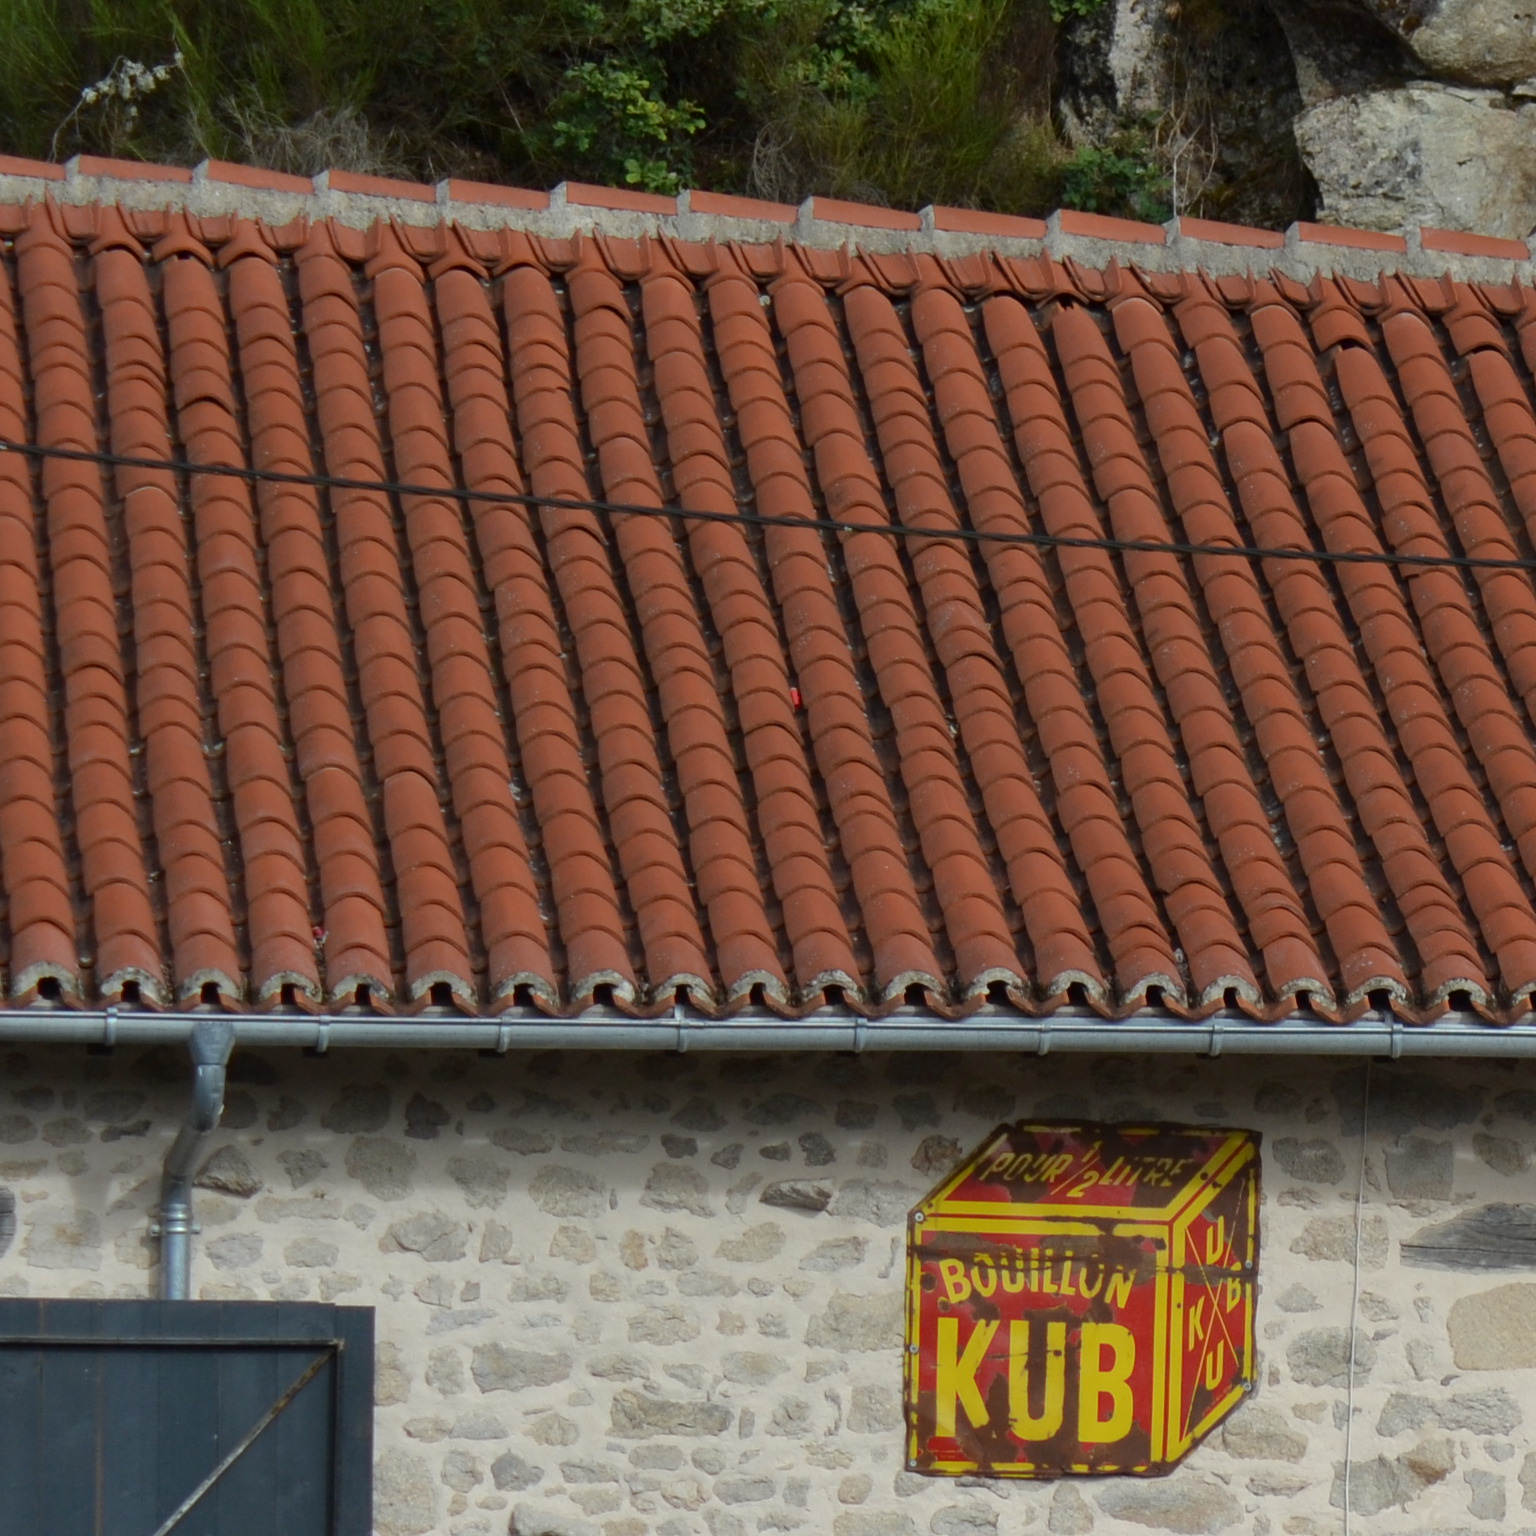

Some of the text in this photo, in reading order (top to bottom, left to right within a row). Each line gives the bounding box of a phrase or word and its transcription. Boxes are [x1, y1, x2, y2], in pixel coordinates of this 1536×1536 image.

[979, 1152, 1073, 1183] POUR
[1098, 1156, 1194, 1187] LITRE
[939, 1247, 1137, 1309] BOUILLON
[935, 1316, 1137, 1443] KUB
